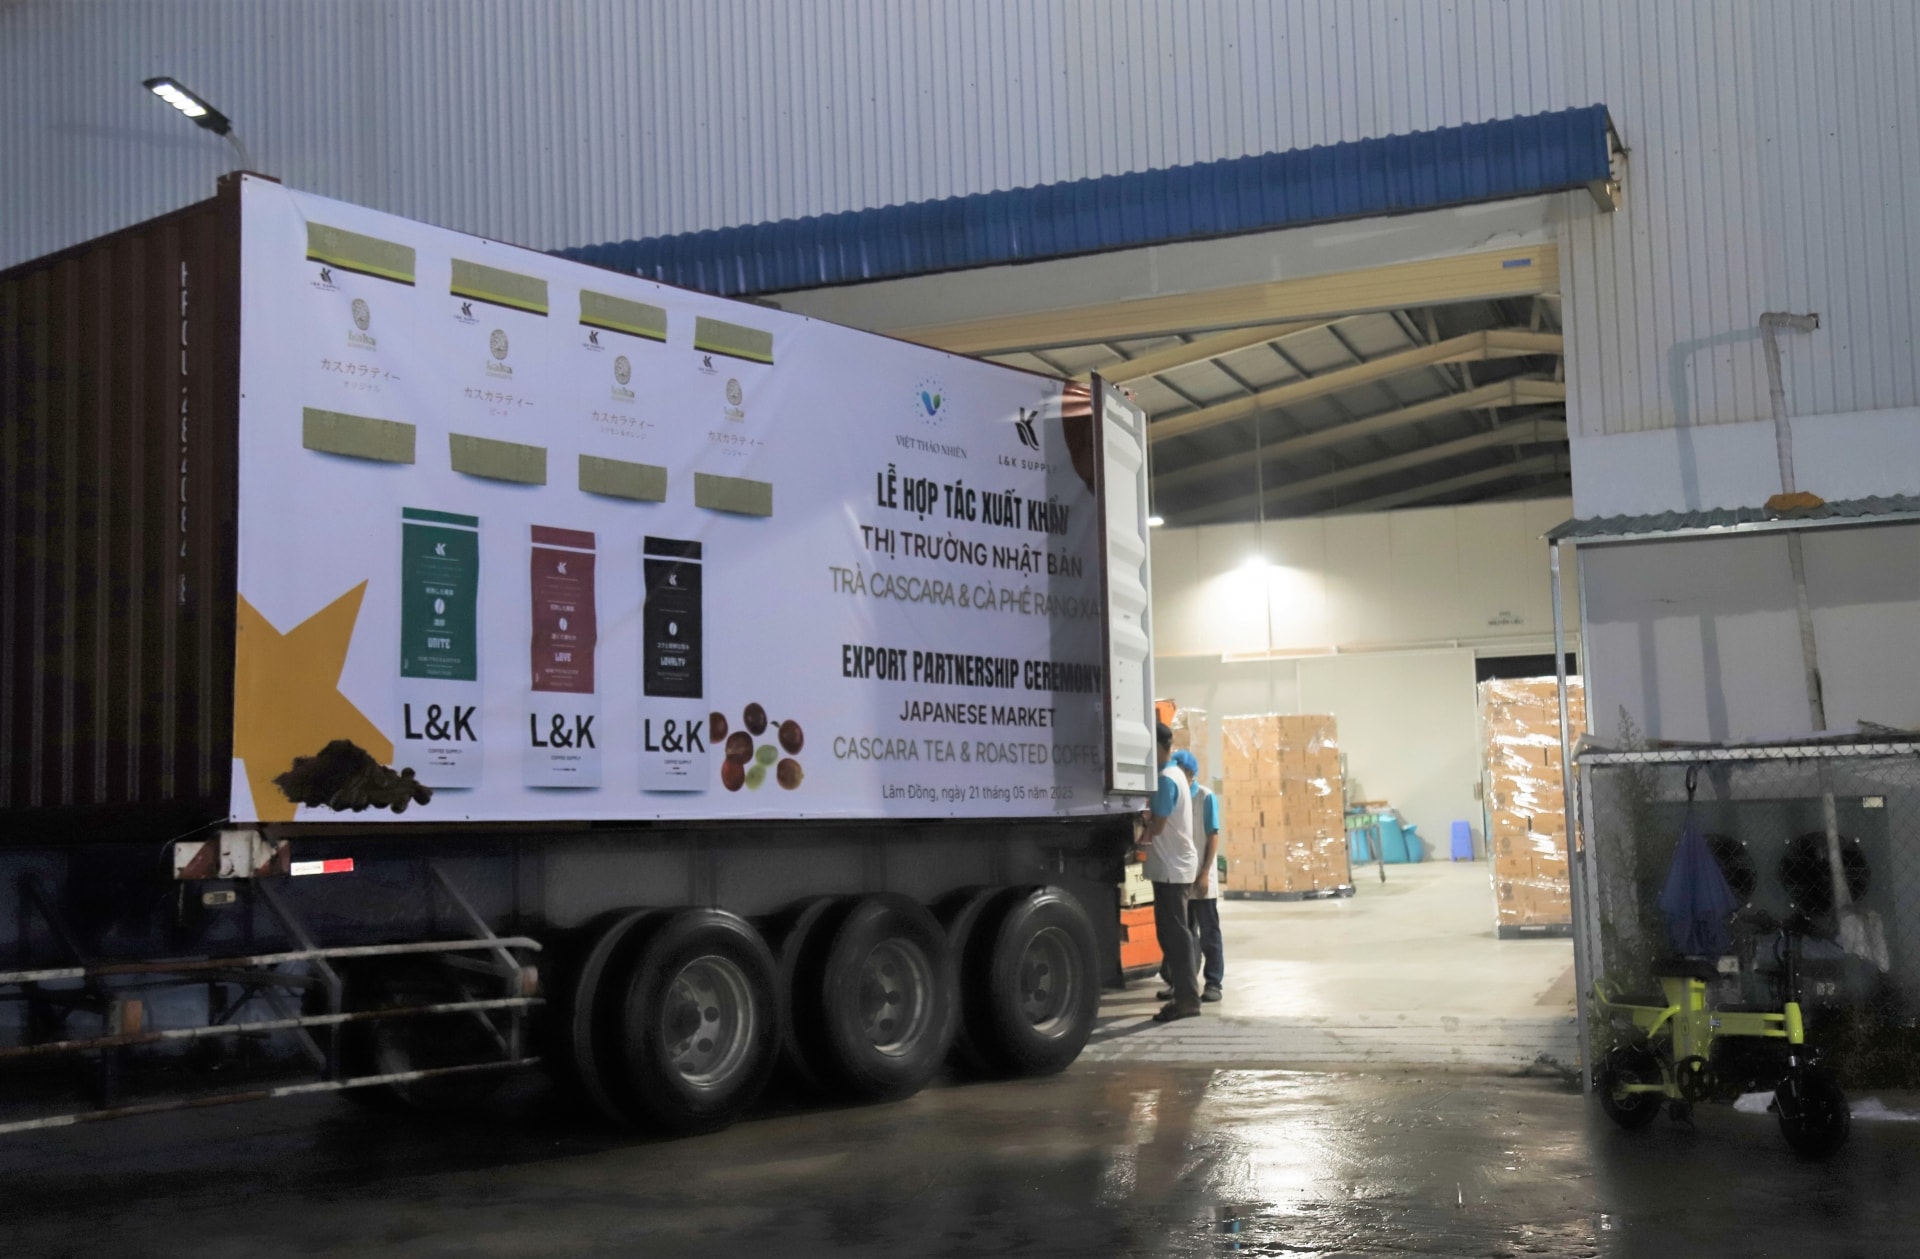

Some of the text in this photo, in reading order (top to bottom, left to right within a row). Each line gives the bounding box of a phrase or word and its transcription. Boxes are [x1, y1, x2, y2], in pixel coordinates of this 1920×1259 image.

[998, 455, 1016, 467] L&K
[877, 463, 897, 510] LỄ
[903, 477, 938, 521] HỢP
[944, 479, 976, 522] TÁC
[982, 488, 1022, 529] XUẤT
[860, 525, 895, 560] THỊ
[900, 531, 988, 567] TRƯỜNG
[992, 543, 1042, 578] NHẬT
[829, 562, 867, 595] TRÀ
[870, 572, 953, 606] CASCARA
[958, 583, 970, 608] &
[973, 580, 997, 611] CÀ
[1000, 585, 1032, 615] PHÊ
[1034, 592, 1079, 618] RANG
[842, 644, 1101, 694] EXPORT PARTNERSHIP CEREMONY
[403, 703, 477, 741] L&K
[530, 712, 596, 749] L&K
[899, 700, 1056, 727] JAPANESE MARKET
[644, 718, 705, 753] L&K
[833, 736, 1099, 766] CASCARA TEA & ROASTED COFFE
[882, 784, 905, 799] Lâm
[942, 785, 966, 802] ngày
[969, 785, 980, 799] 21
[982, 785, 1010, 802] tháng
[1013, 786, 1026, 799] 05
[1028, 786, 1048, 799] năm
[1051, 786, 1073, 800] 2025
